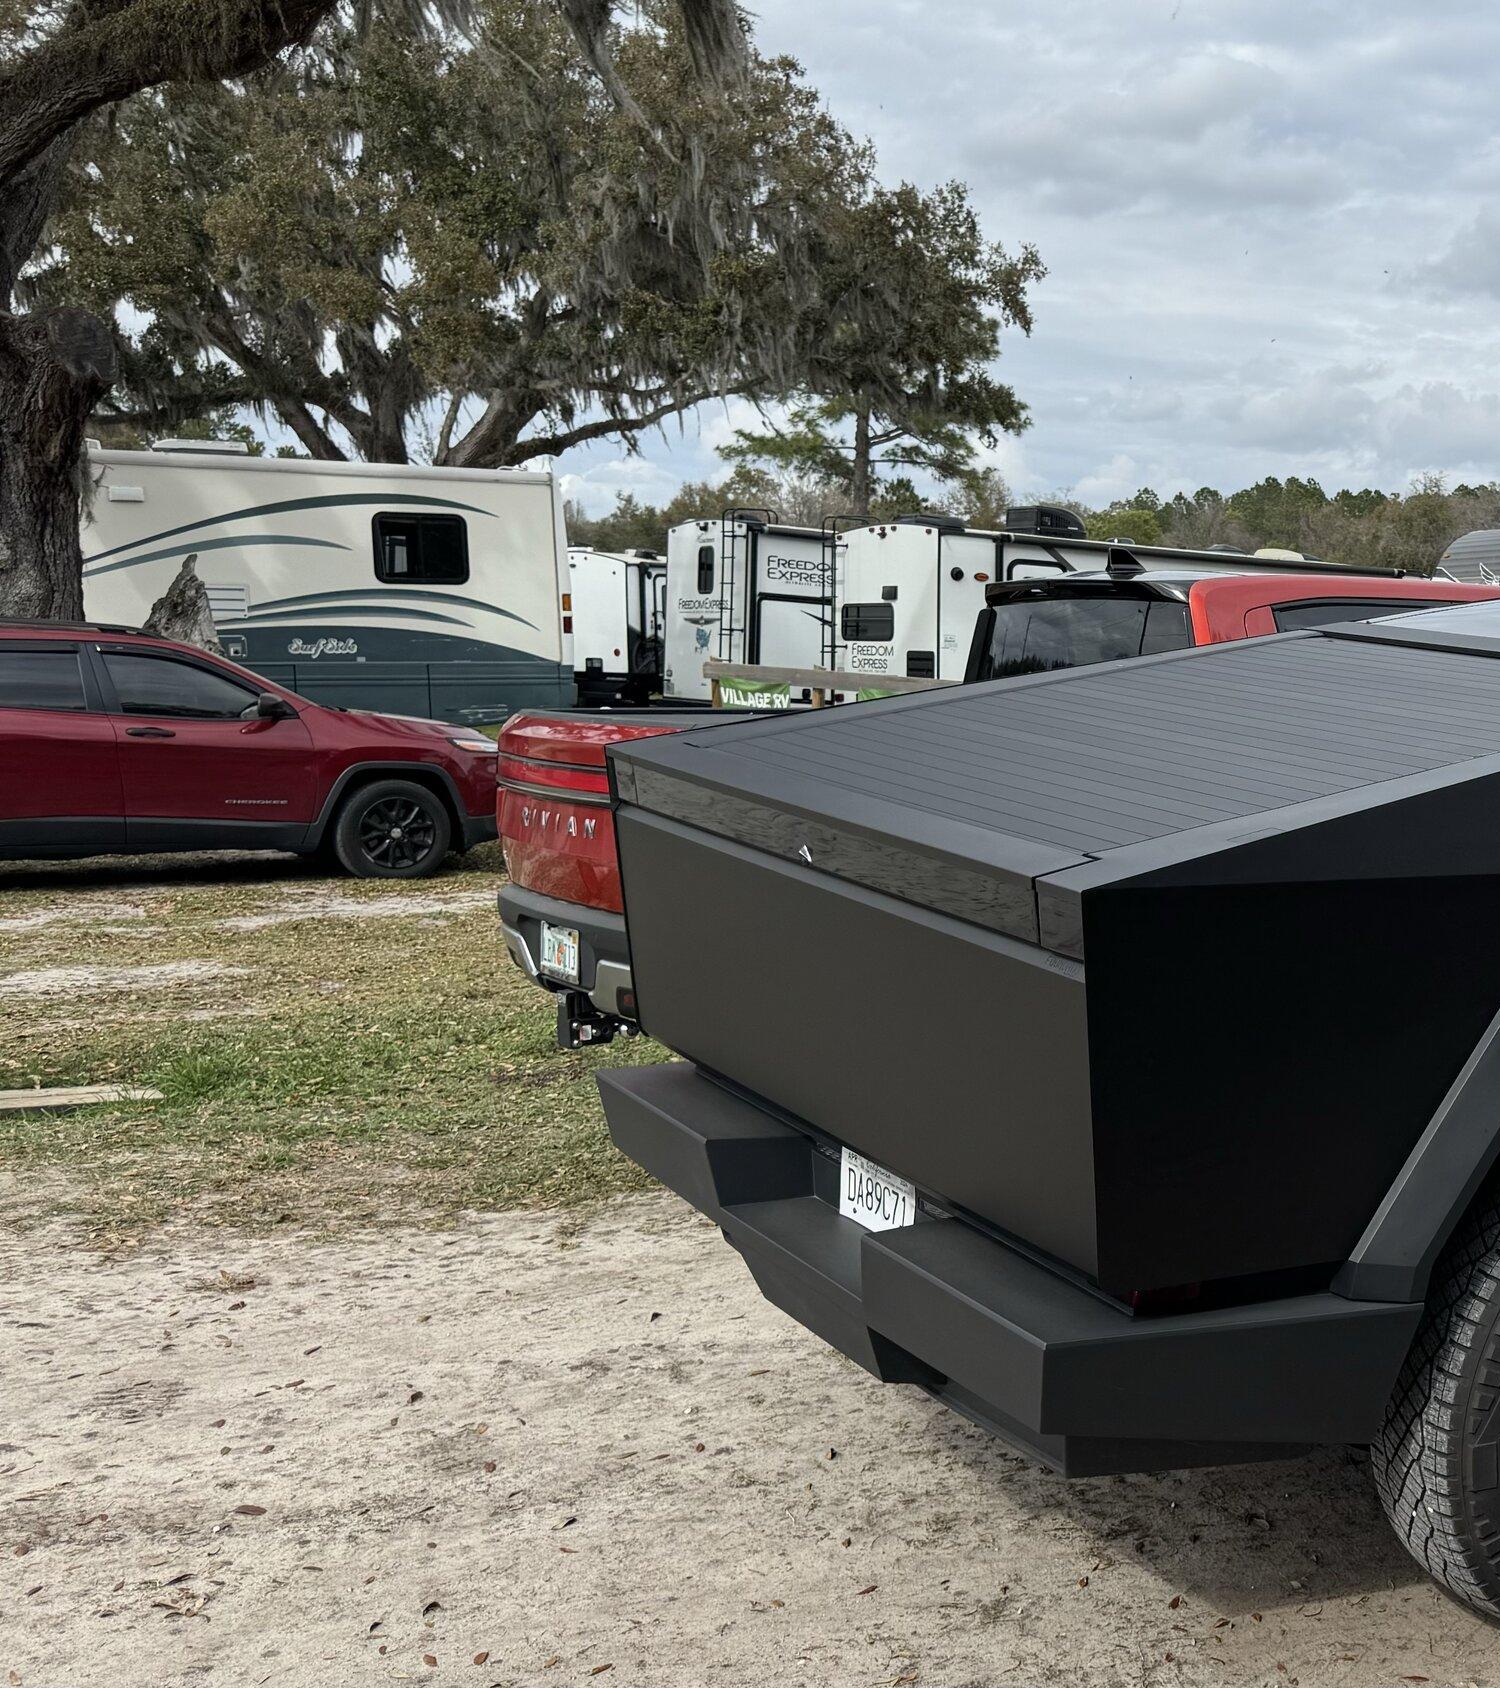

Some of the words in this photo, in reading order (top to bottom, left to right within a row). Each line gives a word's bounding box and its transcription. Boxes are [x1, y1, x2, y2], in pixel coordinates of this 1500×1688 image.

[768, 555, 831, 572] FREEDO
[768, 567, 834, 584] EXPRESS
[288, 638, 326, 658] Surf
[852, 643, 894, 656] FREEDOM
[852, 656, 888, 669] EXPRESS
[720, 687, 772, 708] VILLAGE
[774, 693, 790, 708] RV
[848, 1167, 906, 1229] DA89C71
